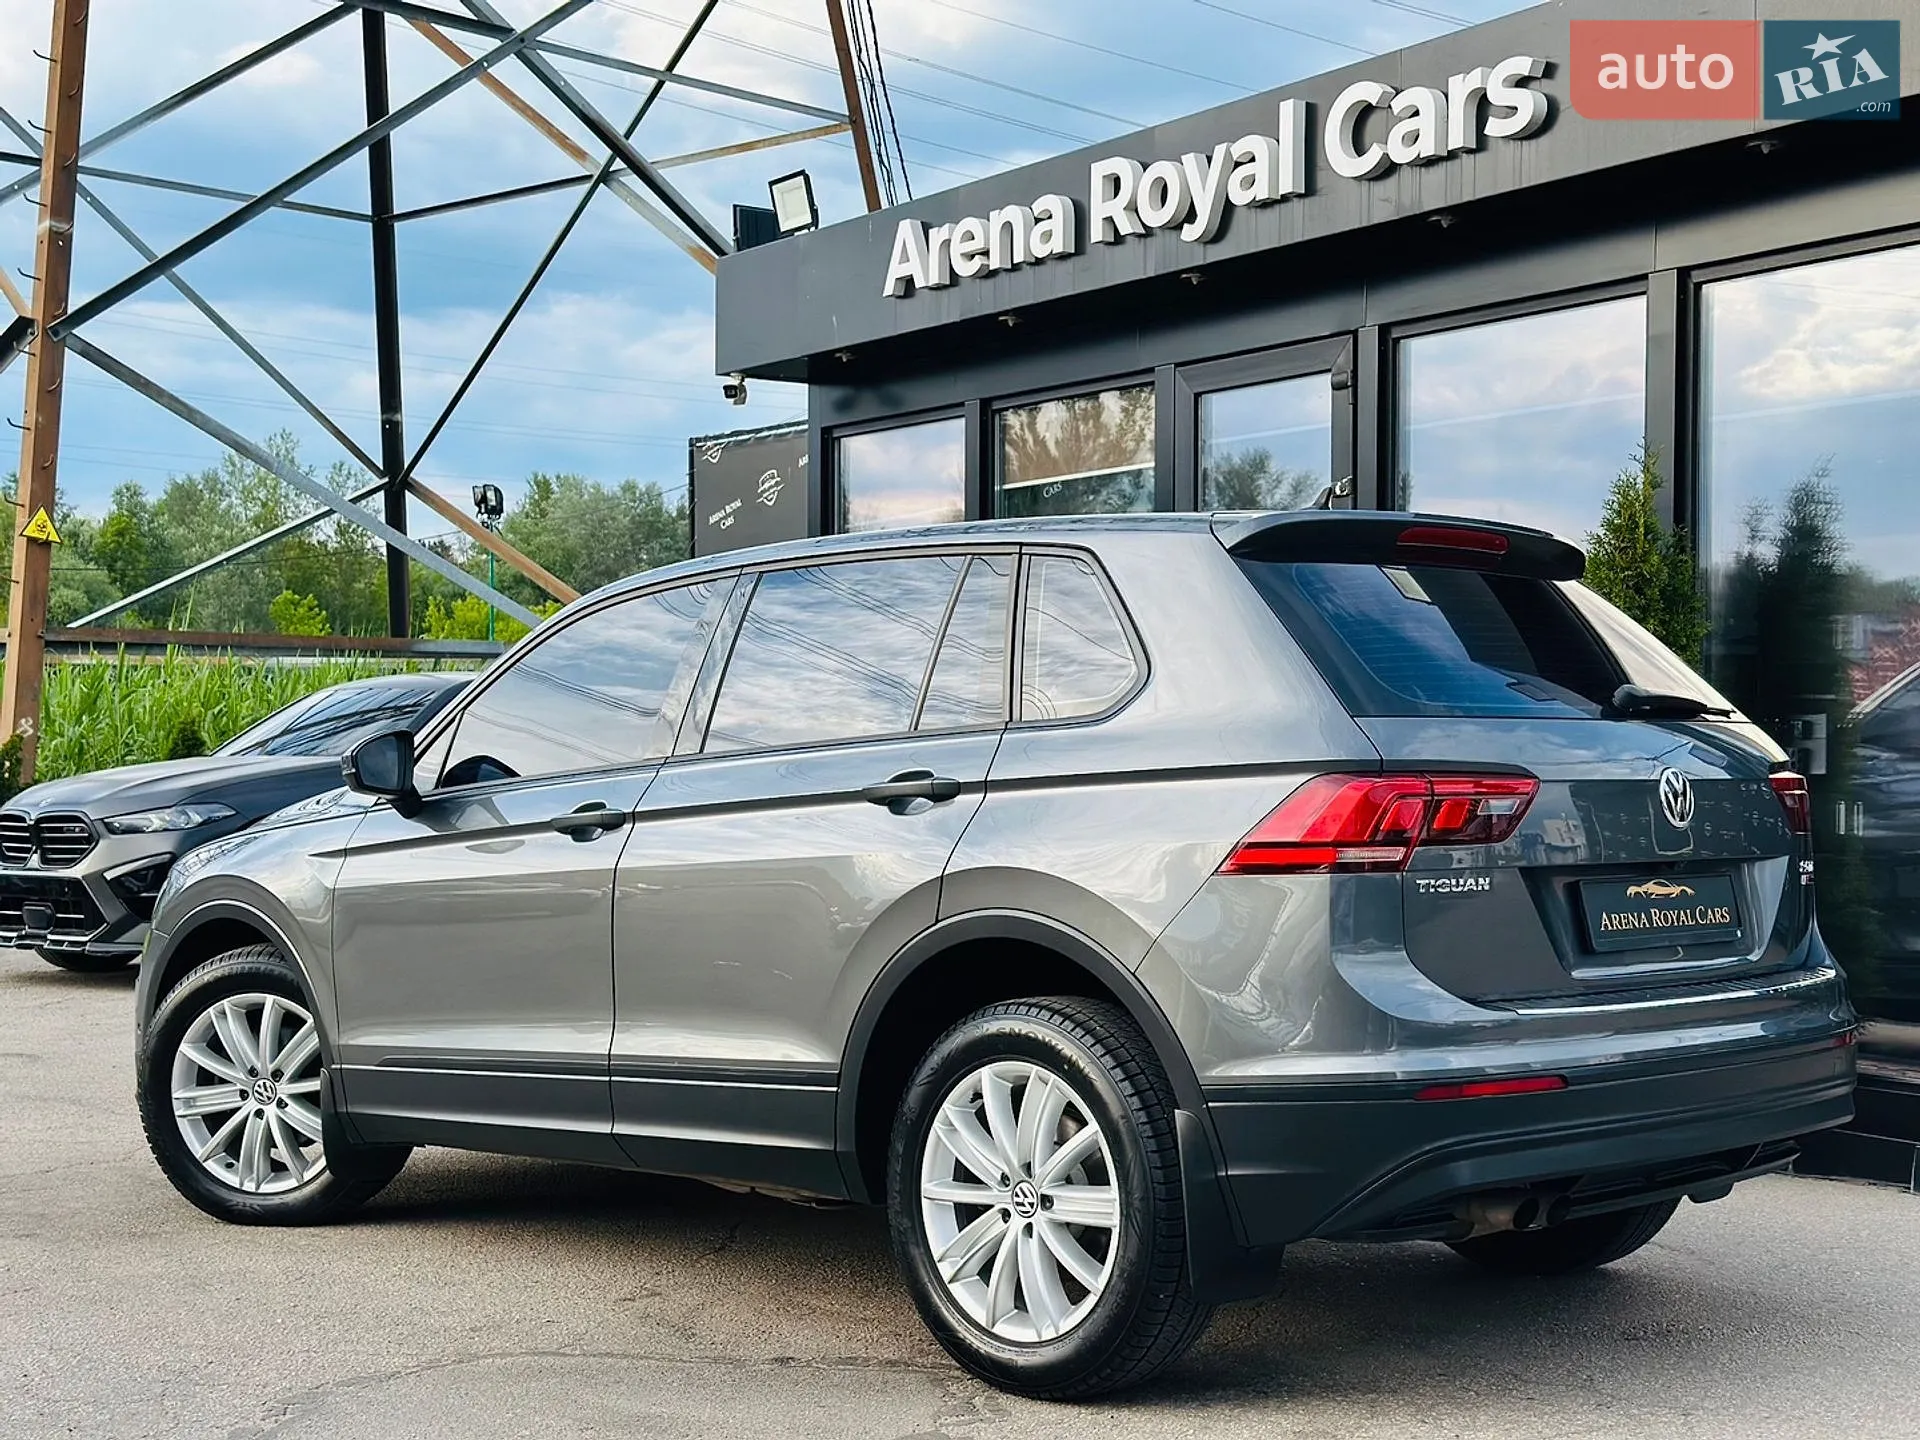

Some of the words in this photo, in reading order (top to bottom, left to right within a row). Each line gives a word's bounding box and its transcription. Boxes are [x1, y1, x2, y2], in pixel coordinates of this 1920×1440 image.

[882, 193, 1076, 297] Arena
[1090, 98, 1307, 243] Royal
[1324, 56, 1548, 180] Cars
[1415, 877, 1491, 893] TIGUAN
[1600, 911, 1650, 931] ARENA
[1650, 907, 1696, 927] ROYAL
[1696, 905, 1731, 924] CARS
